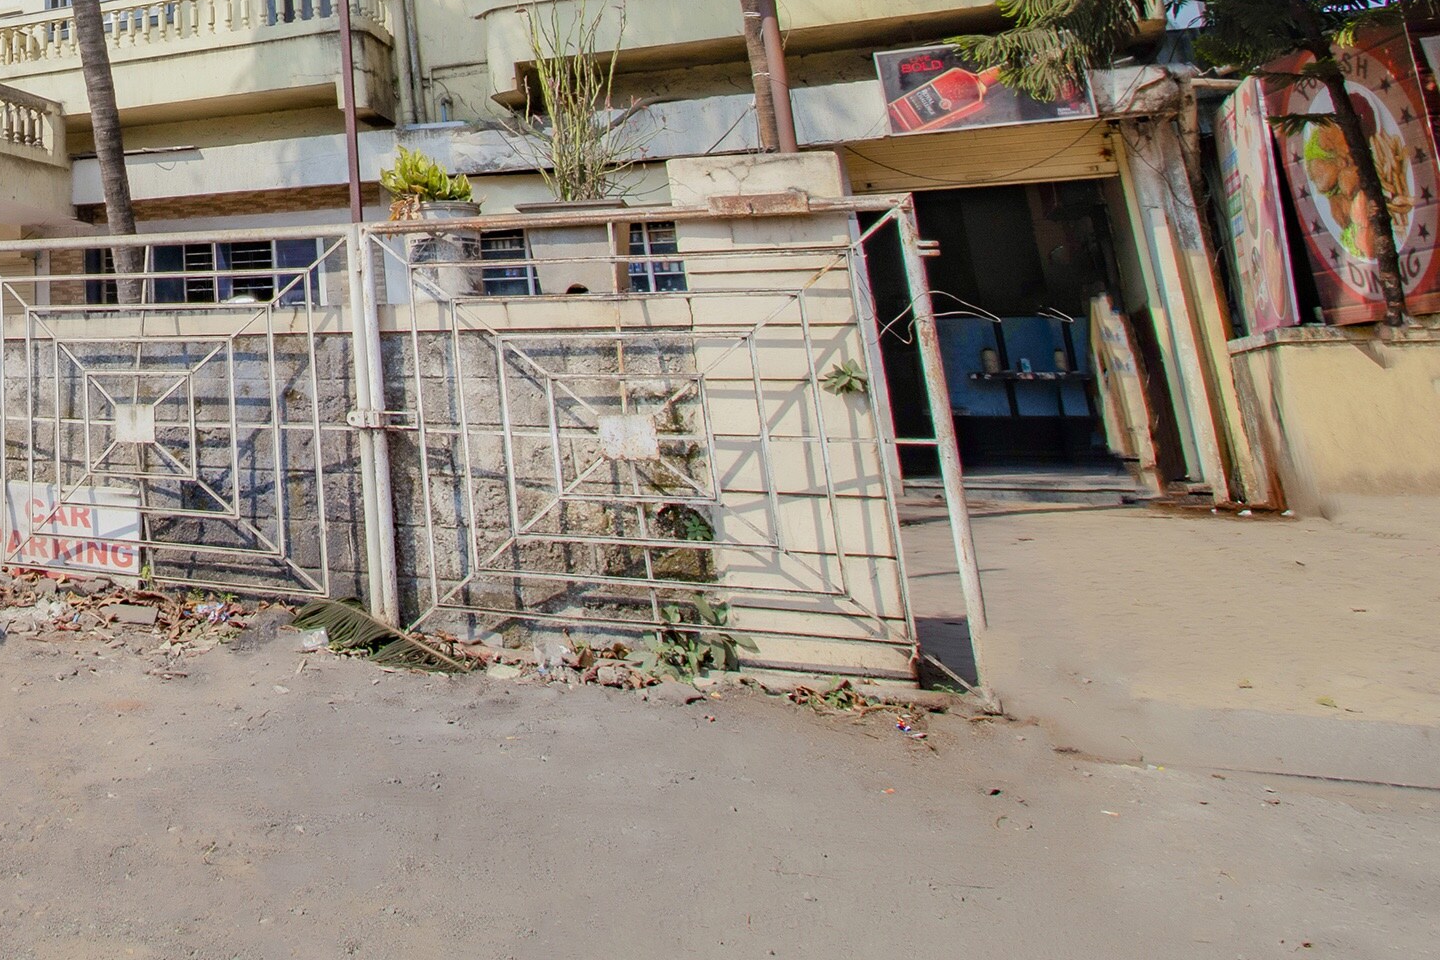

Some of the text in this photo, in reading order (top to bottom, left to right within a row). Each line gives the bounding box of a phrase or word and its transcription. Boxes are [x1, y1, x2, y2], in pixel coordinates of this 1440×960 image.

[901, 59, 944, 74] BOLD
[1346, 257, 1421, 295] DINNG
[25, 498, 92, 529] CAR
